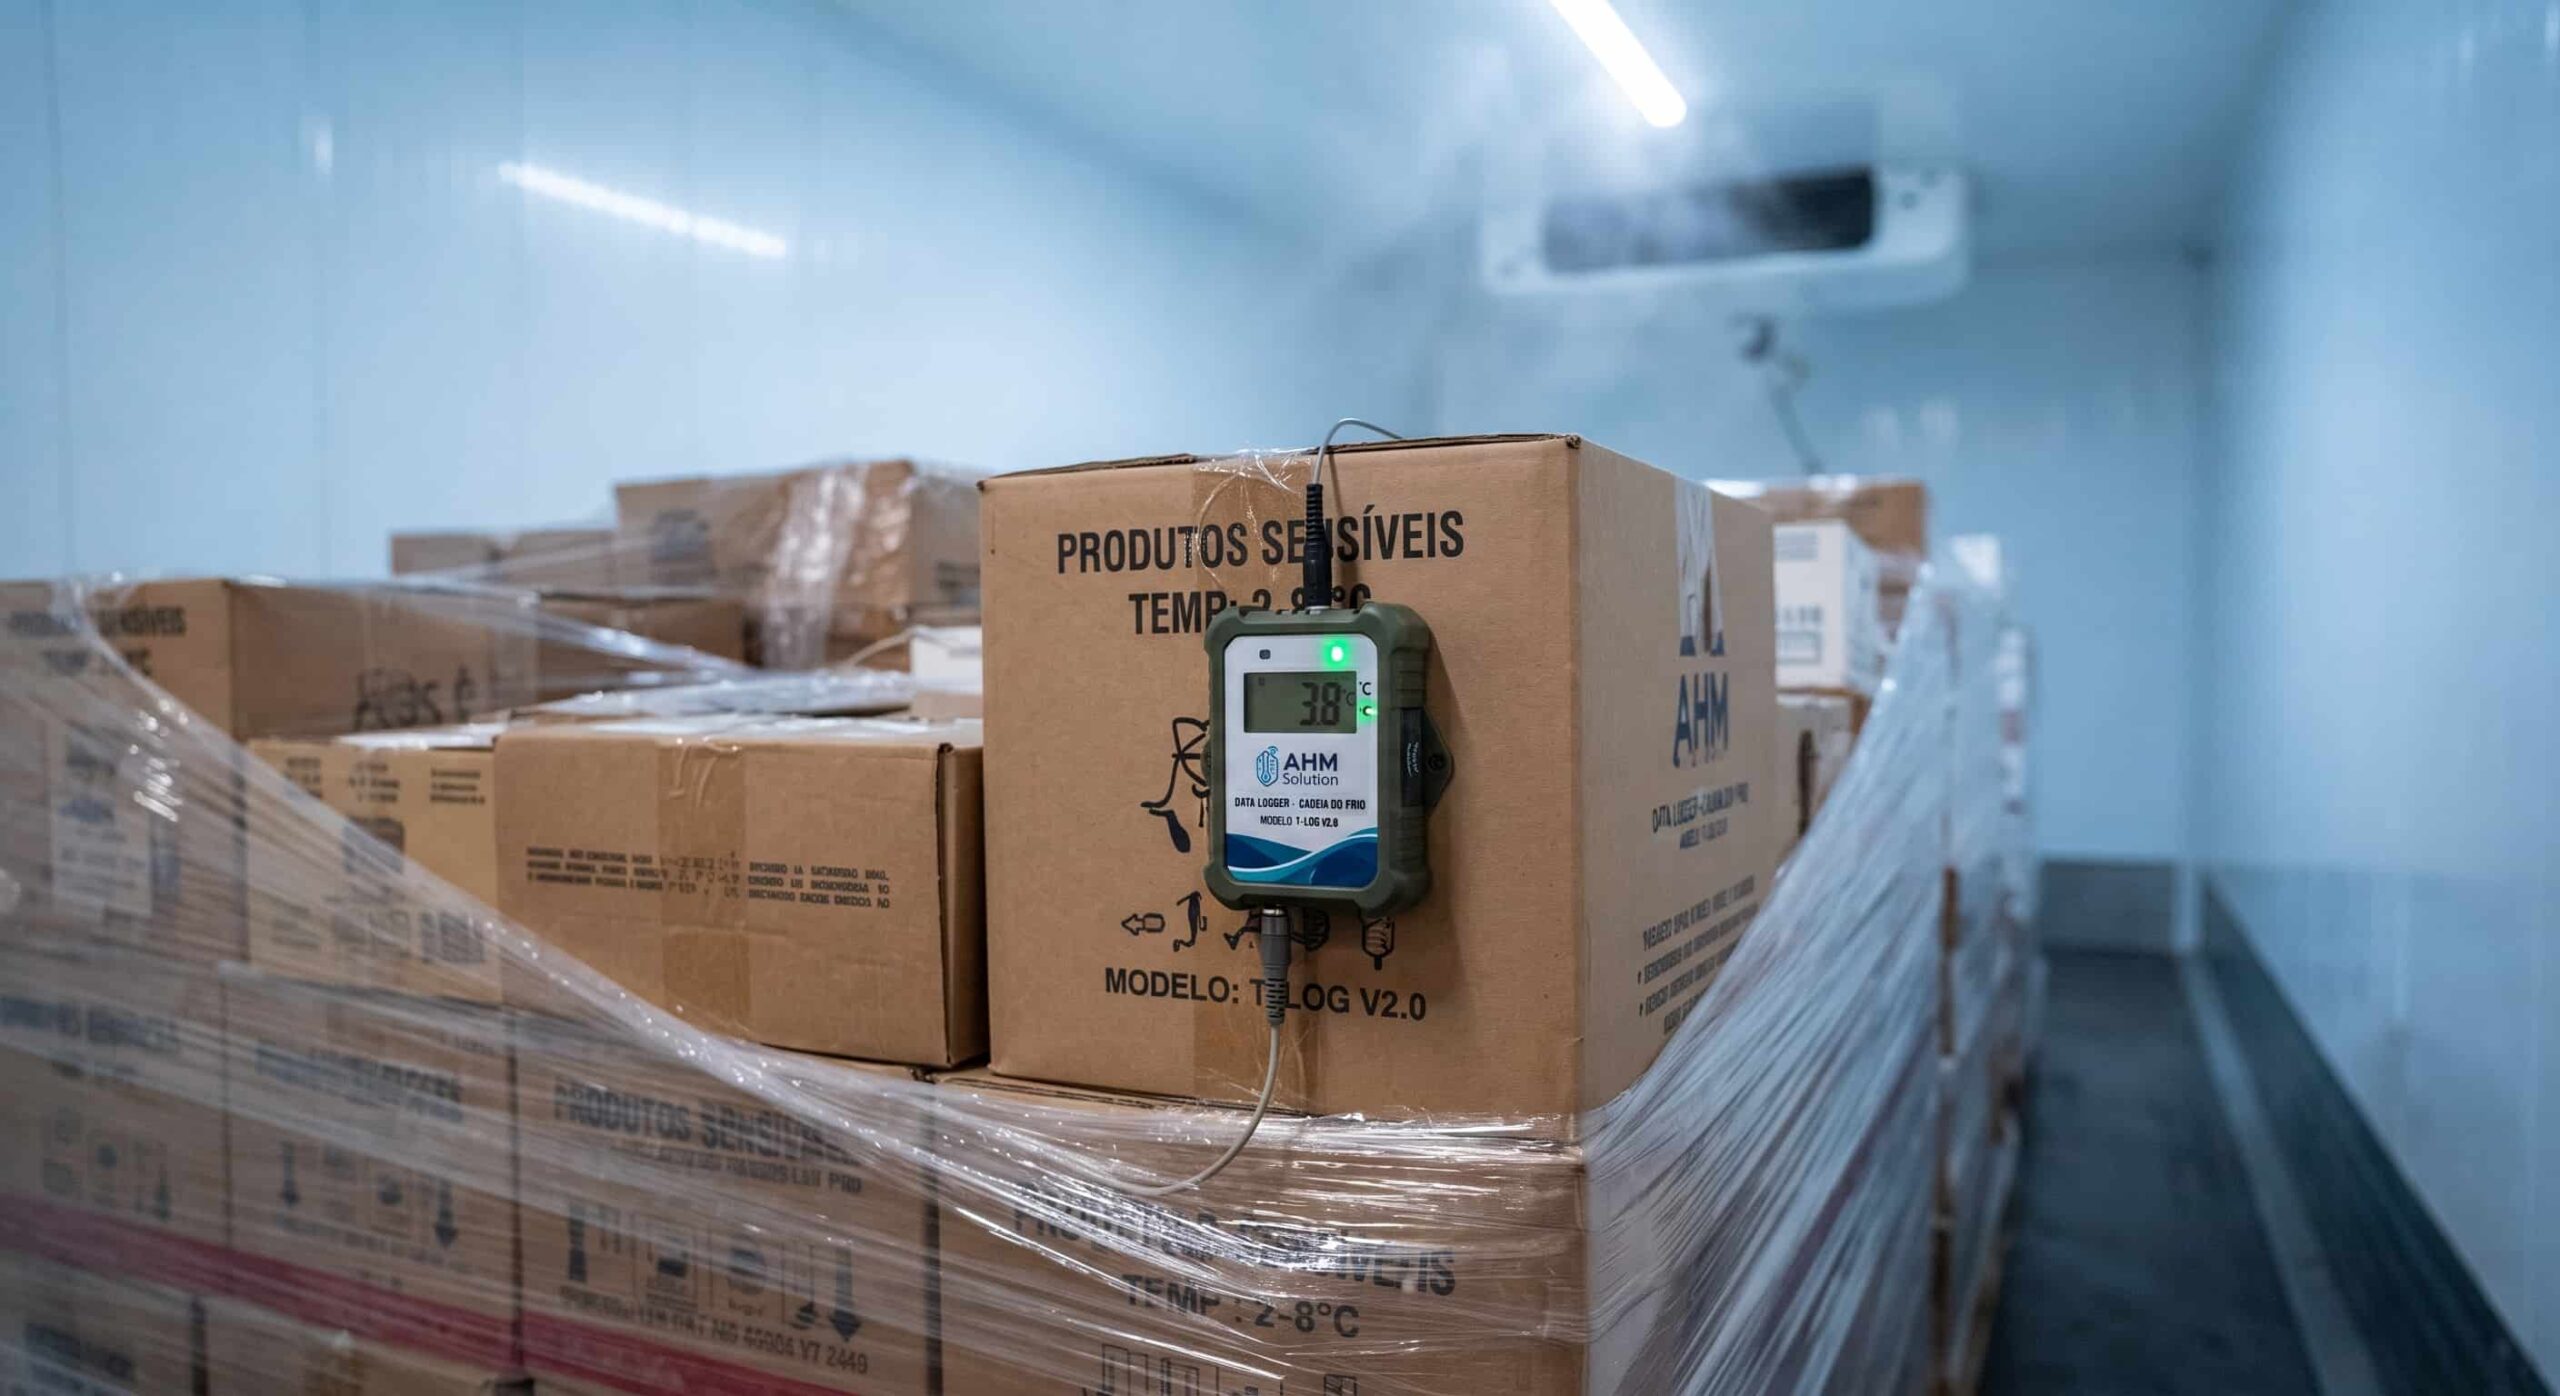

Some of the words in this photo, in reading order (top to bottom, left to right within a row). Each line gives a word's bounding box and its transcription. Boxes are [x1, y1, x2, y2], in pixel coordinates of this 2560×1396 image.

[1057, 521, 1249, 574] PRODUTOS
[1262, 504, 1465, 566] SESÍVEIS
[1299, 681, 1342, 726] 3.8
[1673, 671, 1729, 766] AHM
[1282, 772, 1339, 786] Solution
[1283, 752, 1338, 772] AHM
[1234, 797, 1255, 808] DATA
[1257, 797, 1290, 808] LOGGER
[1298, 798, 1329, 810] CADEIA
[1330, 799, 1343, 810] DO
[1345, 799, 1366, 810] FRIO
[1260, 815, 1292, 826] MODELO
[1104, 967, 1240, 1005] MODELO:
[1250, 978, 1351, 1013] TLOG
[1360, 987, 1428, 1021] V2.0
[1254, 1300, 1360, 1338] 2-8°C
